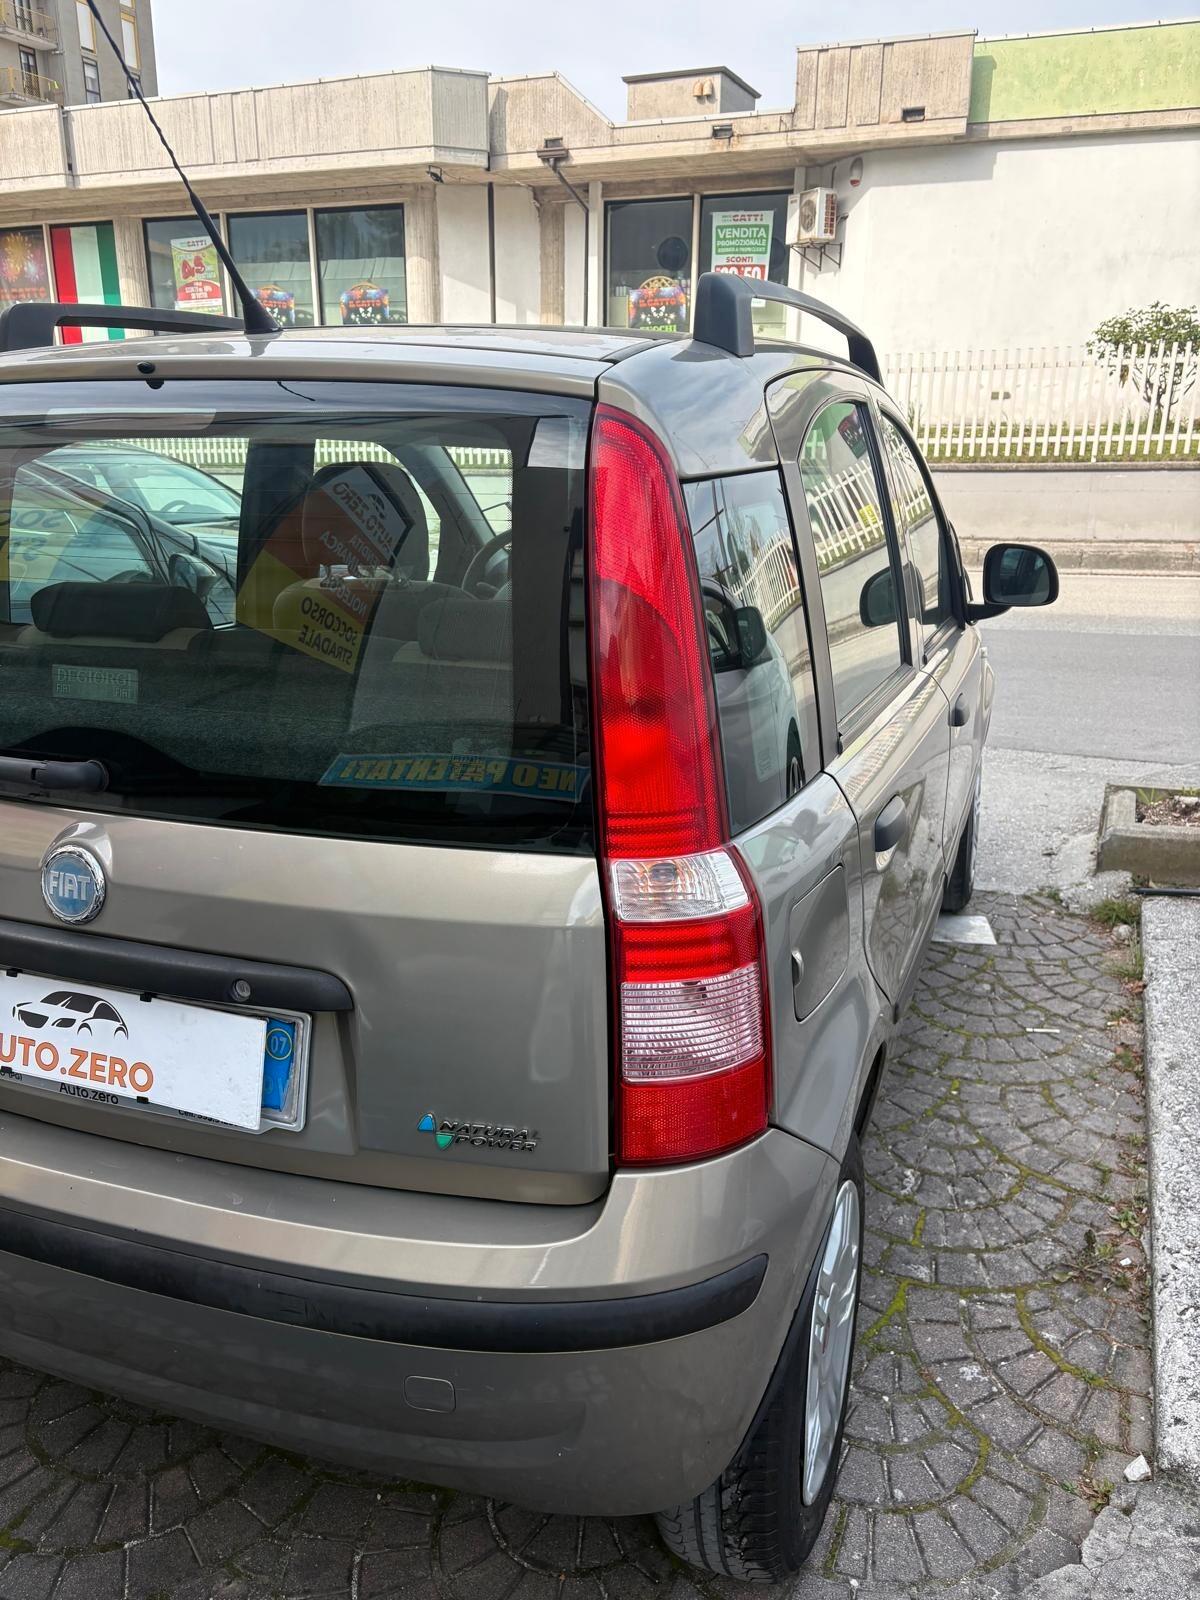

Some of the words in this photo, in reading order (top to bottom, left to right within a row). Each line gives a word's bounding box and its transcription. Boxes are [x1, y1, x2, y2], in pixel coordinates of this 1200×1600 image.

[732, 213, 764, 222] GATTI
[717, 227, 767, 238] VENDITA
[49, 870, 91, 901] FIAT
[270, 1035, 288, 1055] 07
[0, 1032, 154, 1093] UTO.ZERO
[59, 1082, 119, 1106] Auto.zero
[455, 1135, 537, 1152] POWER
